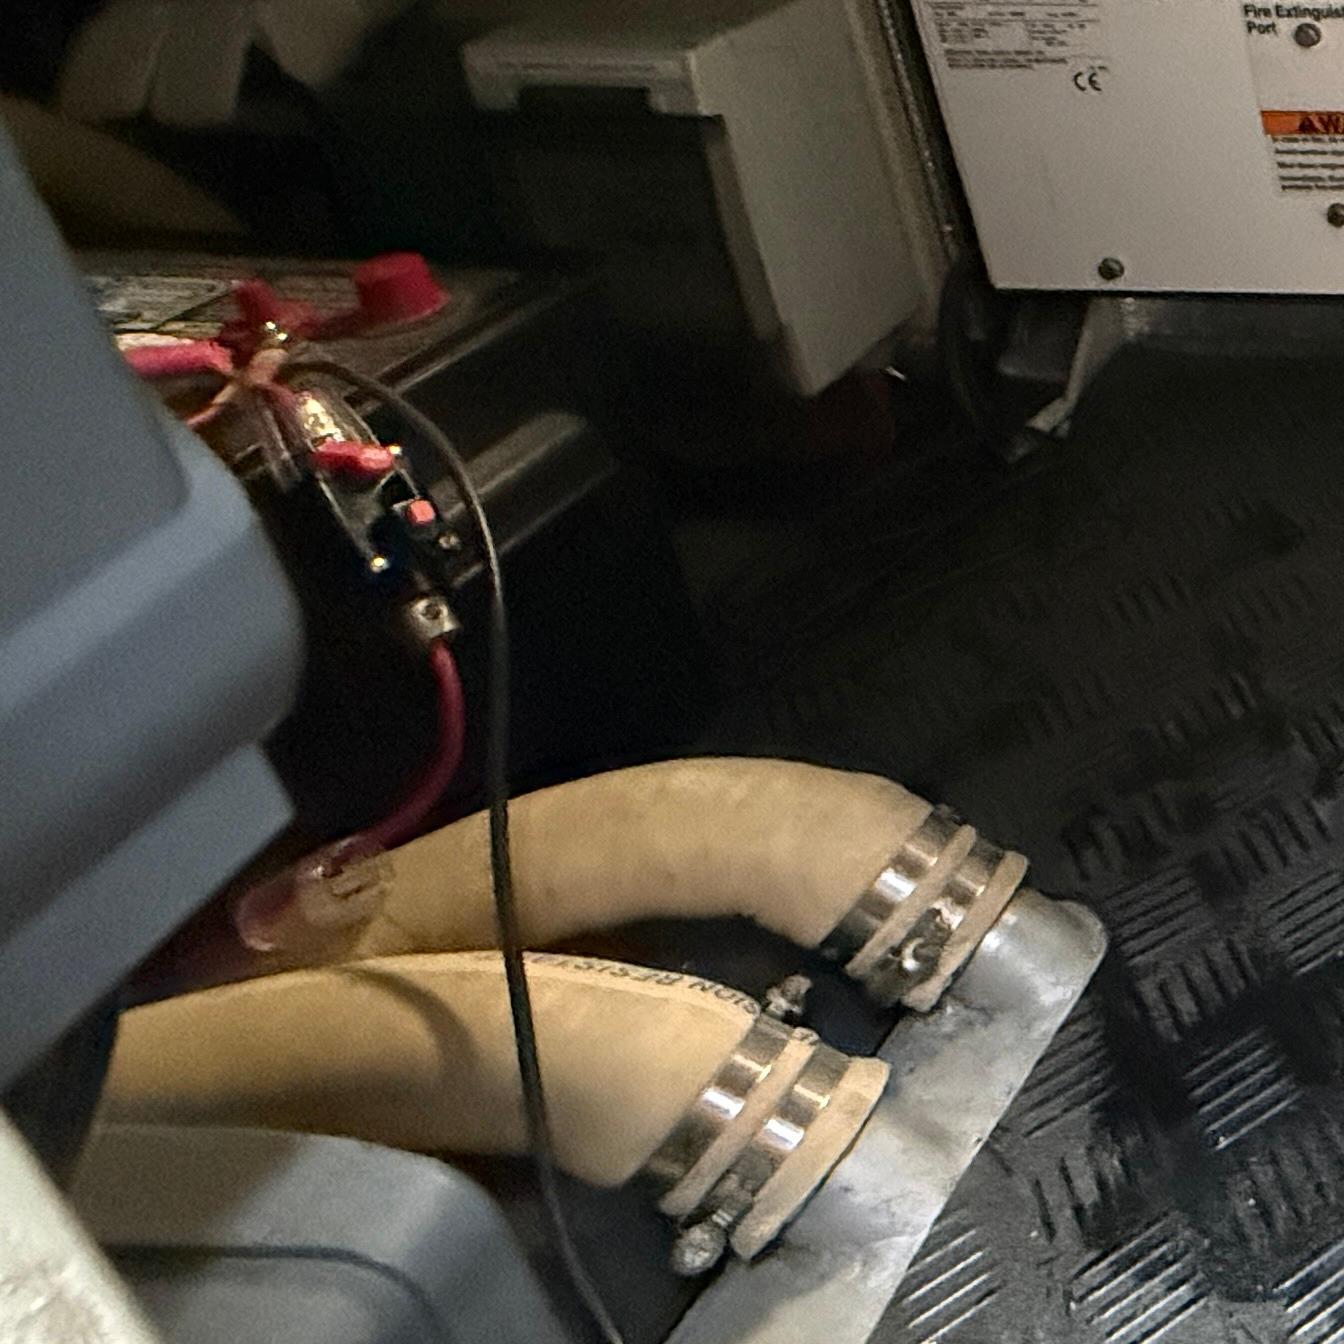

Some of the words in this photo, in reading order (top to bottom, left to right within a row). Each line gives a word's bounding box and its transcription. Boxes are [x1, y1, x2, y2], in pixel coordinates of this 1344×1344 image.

[1243, 4, 1273, 18] Fire
[1246, 22, 1278, 36] Port
[688, 980, 761, 1016] SION
